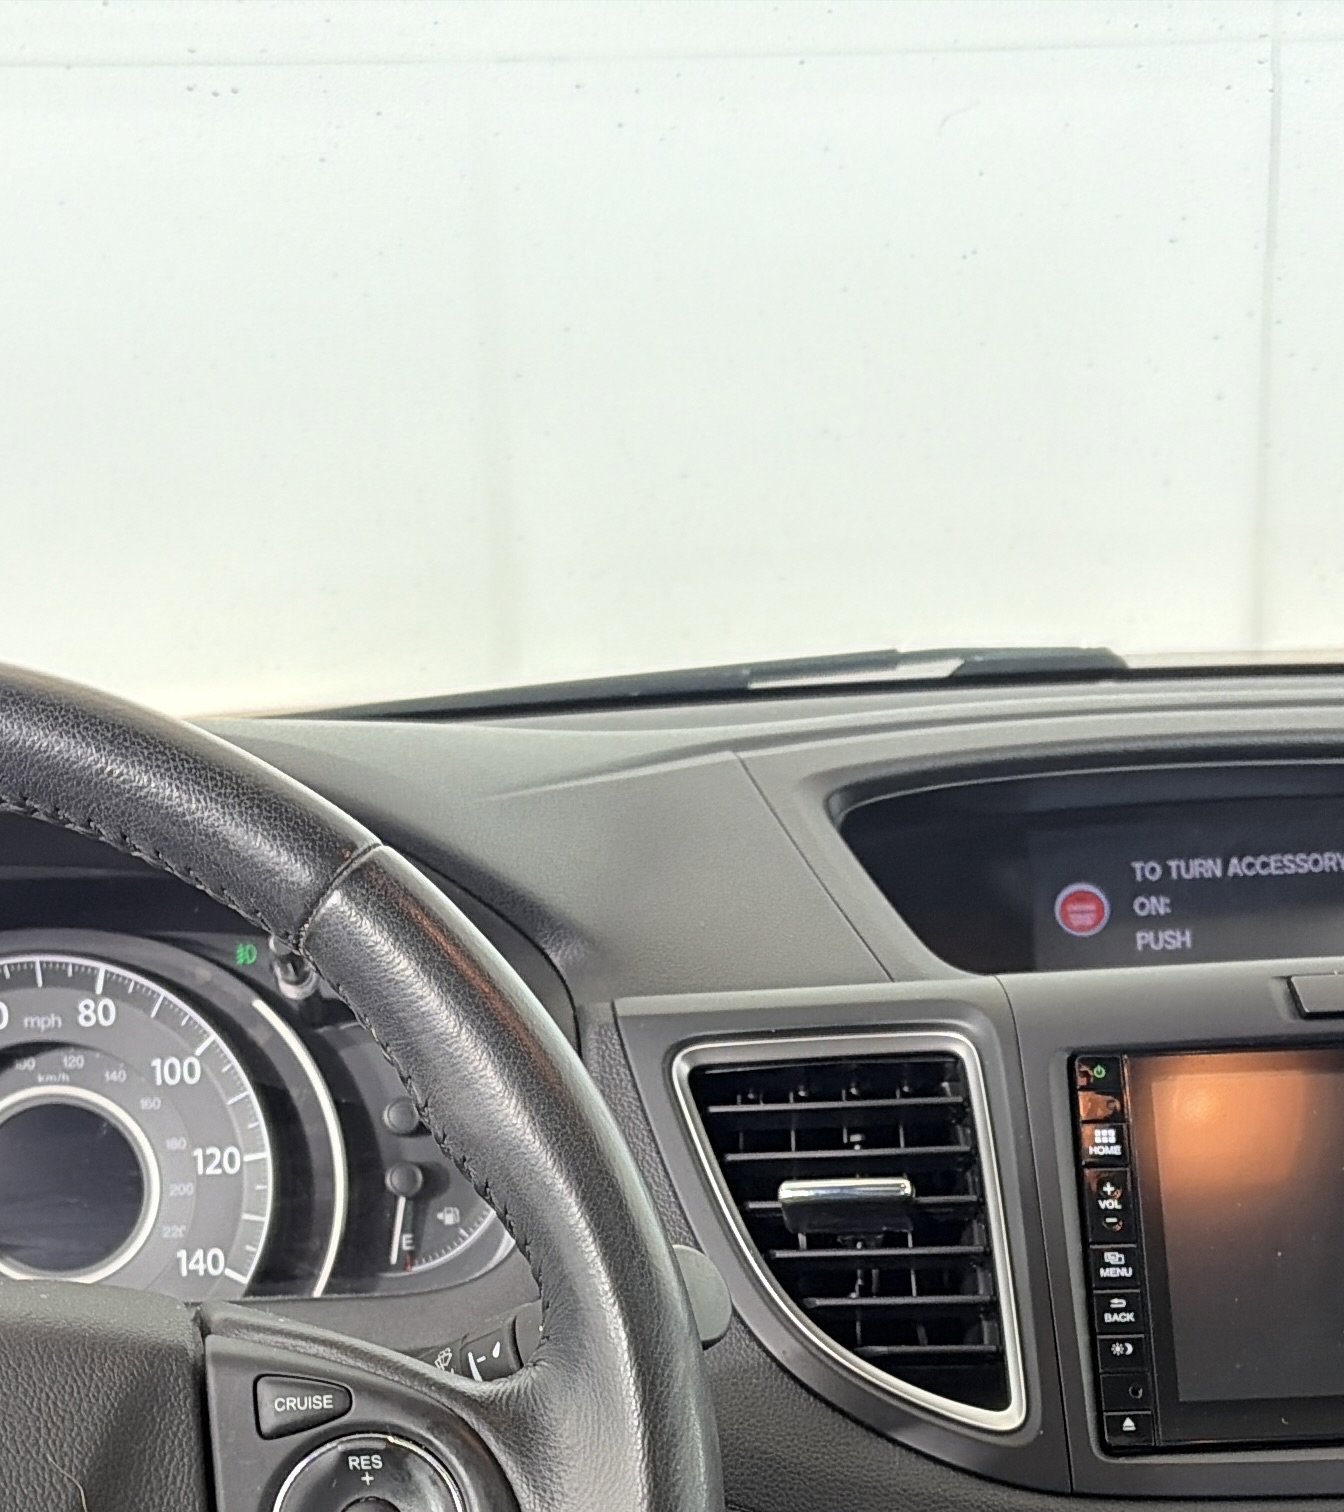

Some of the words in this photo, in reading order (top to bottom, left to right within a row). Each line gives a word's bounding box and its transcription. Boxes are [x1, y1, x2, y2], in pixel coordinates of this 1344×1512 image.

[1131, 860, 1163, 882] TO
[1166, 857, 1222, 881] TURN
[1133, 896, 1172, 917] ON:
[1135, 929, 1192, 951] PUSH
[78, 999, 116, 1027] 80
[23, 1012, 62, 1032] mph
[63, 1054, 84, 1069] 120
[37, 1072, 70, 1083] km/h
[105, 1069, 126, 1083] 140
[150, 1056, 201, 1086] 100
[1089, 1145, 1121, 1156] HOME
[193, 1146, 240, 1175] 120
[169, 1183, 194, 1196] 200
[1098, 1200, 1122, 1210] VOL
[402, 1233, 415, 1250] E
[176, 1248, 225, 1277] 140
[1099, 1266, 1133, 1278] MENU
[1104, 1312, 1135, 1323] BACK
[274, 1394, 334, 1412] CRUISE
[348, 1454, 383, 1470] RES
